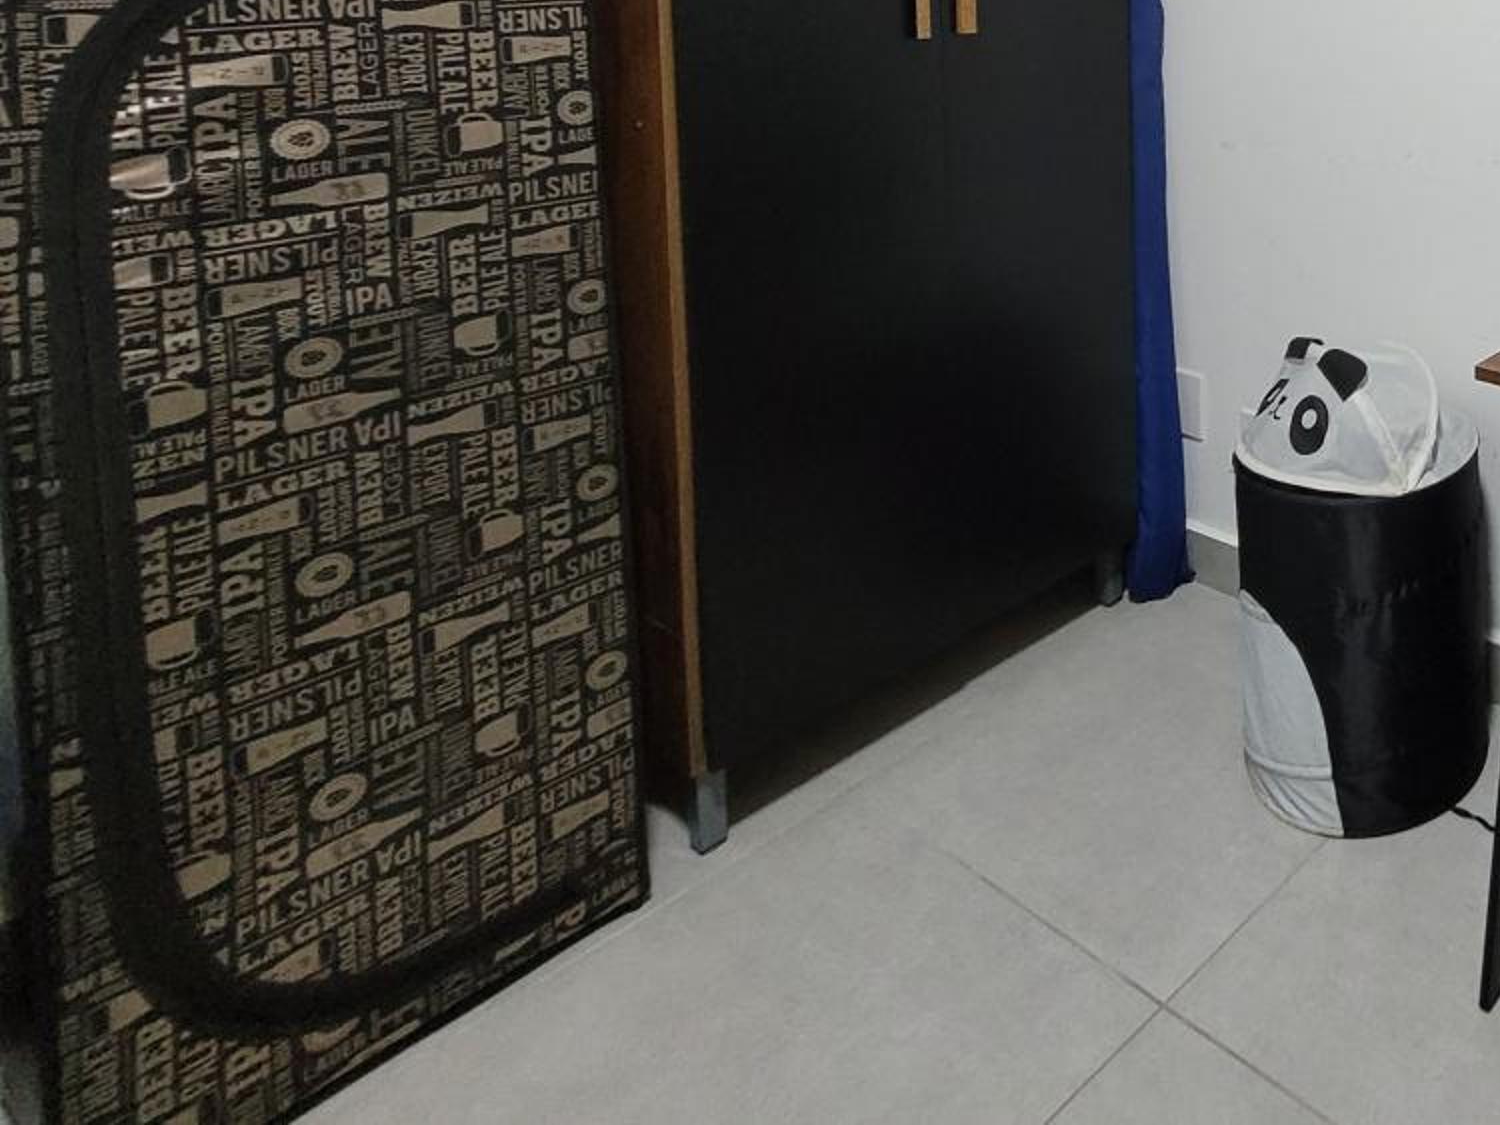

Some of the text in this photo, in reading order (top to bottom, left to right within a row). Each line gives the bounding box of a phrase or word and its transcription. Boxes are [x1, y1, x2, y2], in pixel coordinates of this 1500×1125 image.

[186, 29, 326, 56] LAGER
[497, 5, 588, 33] ILSNER
[291, 52, 312, 110] STOUT
[312, 49, 330, 109] IMPERIAL
[330, 24, 360, 102] BREW
[356, 21, 382, 101] LAGER
[399, 32, 429, 93] EXPORT
[435, 32, 470, 115] PALE ALE
[468, 30, 499, 111] BEER
[572, 30, 589, 81] STOUT
[142, 52, 189, 148] PALE ALE
[192, 91, 239, 165] IPA
[335, 116, 391, 173] ALE
[404, 109, 440, 182] DUNKEL
[519, 116, 554, 177] IPA
[557, 125, 595, 145] LAGE
[244, 160, 265, 219] PORTER
[271, 159, 334, 183] LAGER
[395, 182, 504, 212] WEIZEN
[200, 210, 337, 248] LAGER
[203, 237, 339, 284] PILSNER
[341, 205, 364, 284] LAGER
[362, 202, 391, 277] BREW
[478, 227, 507, 263] ALE
[304, 269, 326, 326] STOUT
[345, 281, 393, 316] IPA
[410, 236, 440, 299] EXPORT
[448, 233, 479, 318] BEER
[481, 263, 511, 312] PALE
[160, 282, 201, 380] BEER
[349, 324, 403, 379] ALE
[413, 311, 452, 385] DUNKEL
[529, 307, 563, 372] IPA
[282, 375, 347, 404] LAGER
[407, 378, 515, 420] WEIZEN
[518, 356, 612, 393] AGER
[230, 375, 277, 448] IPA
[353, 410, 402, 447] IPA
[130, 446, 207, 479] ZEN
[214, 427, 349, 484] PILSNER
[215, 458, 351, 515] LAGER
[382, 442, 405, 524] LAGER
[421, 441, 450, 506] EXPORT
[459, 431, 488, 481] PALE
[490, 424, 521, 508] BEER
[353, 450, 385, 531] BREW
[540, 497, 574, 564] IPA
[173, 554, 216, 618] PALE
[218, 540, 265, 621] IPA
[528, 539, 624, 598] PILSNER
[529, 569, 625, 622] LAGER
[224, 638, 362, 706] LAGER
[385, 620, 416, 701] BREW
[471, 633, 501, 724] BEER
[227, 667, 363, 744] PILSNER
[369, 703, 417, 748] IPA
[551, 689, 583, 761] IPA
[537, 723, 634, 783] LAGER
[539, 745, 635, 816] PILSNER
[185, 745, 230, 851] BEER
[255, 821, 302, 908] IPA
[373, 827, 423, 877] IPA
[509, 816, 539, 906] BEER
[235, 858, 371, 947] PILSNER
[236, 891, 372, 975] LAGER
[373, 875, 405, 961] BREW
